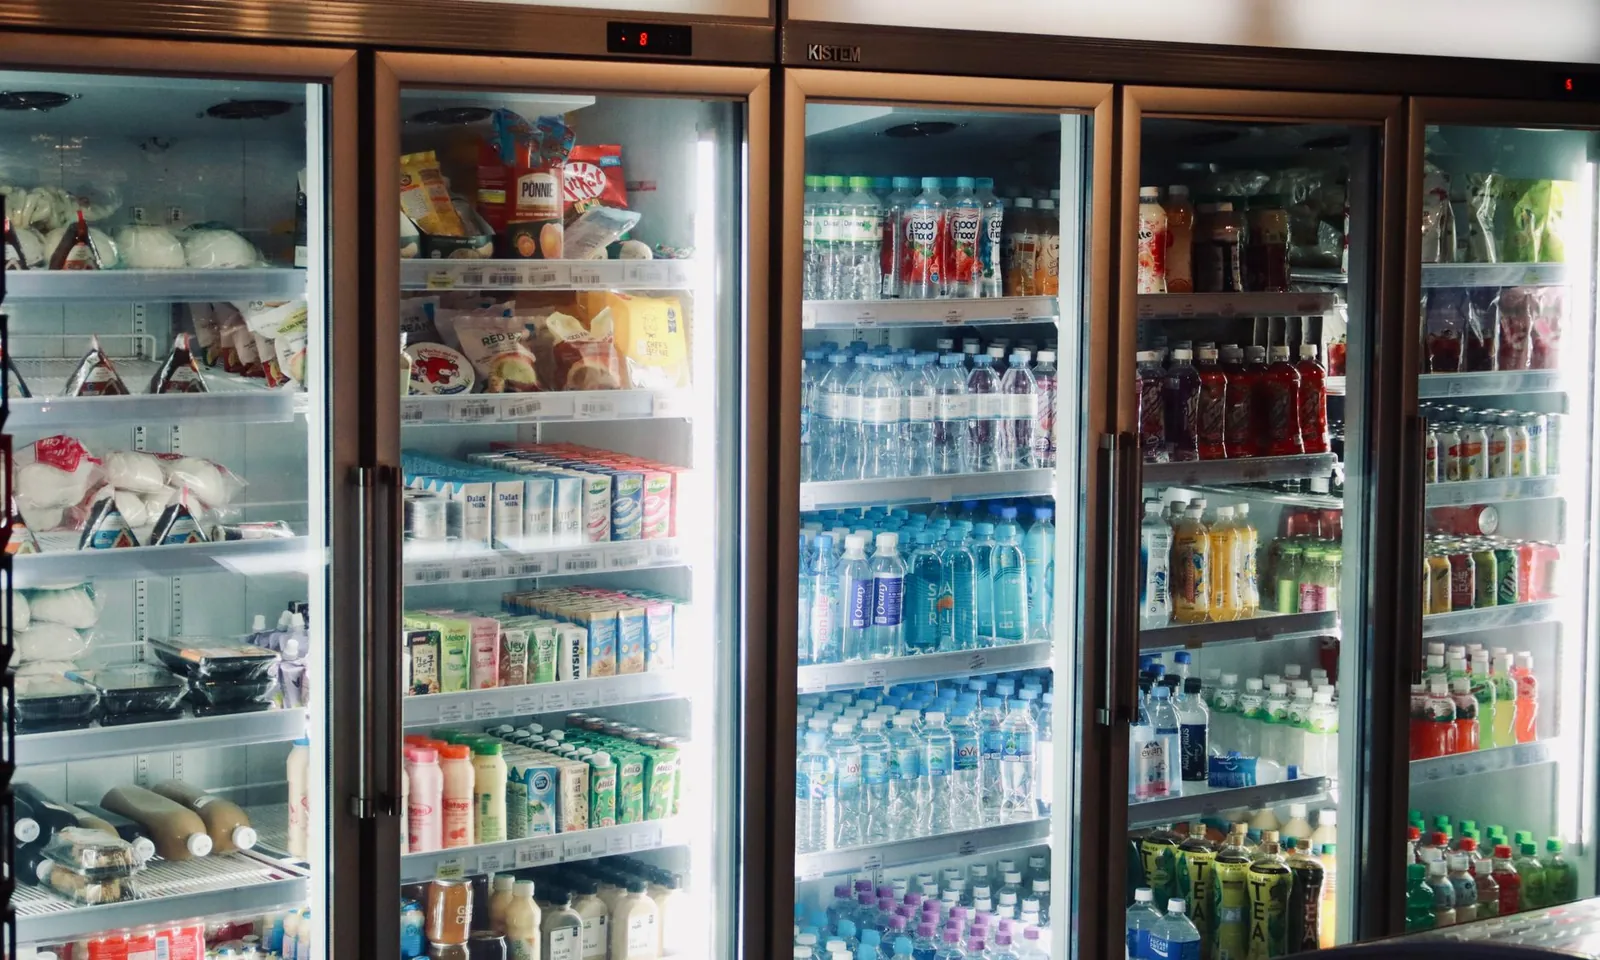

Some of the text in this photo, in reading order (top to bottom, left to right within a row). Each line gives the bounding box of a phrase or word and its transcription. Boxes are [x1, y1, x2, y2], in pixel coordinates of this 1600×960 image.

[639, 32, 647, 46] 8
[807, 43, 861, 63] KISTEM
[521, 181, 553, 198] PONNIE
[953, 221, 977, 232] good
[953, 231, 976, 240] mood
[482, 331, 505, 346] RED
[466, 495, 486, 503] Dalat
[855, 584, 866, 618] Ocany
[877, 583, 888, 615] Ocany
[572, 639, 580, 680] ATSIDE
[1141, 747, 1163, 758] evan
[624, 766, 641, 774] MILO
[1192, 861, 1208, 921] TEA
[1250, 880, 1266, 943] TEA
[1303, 884, 1320, 943] TEA
